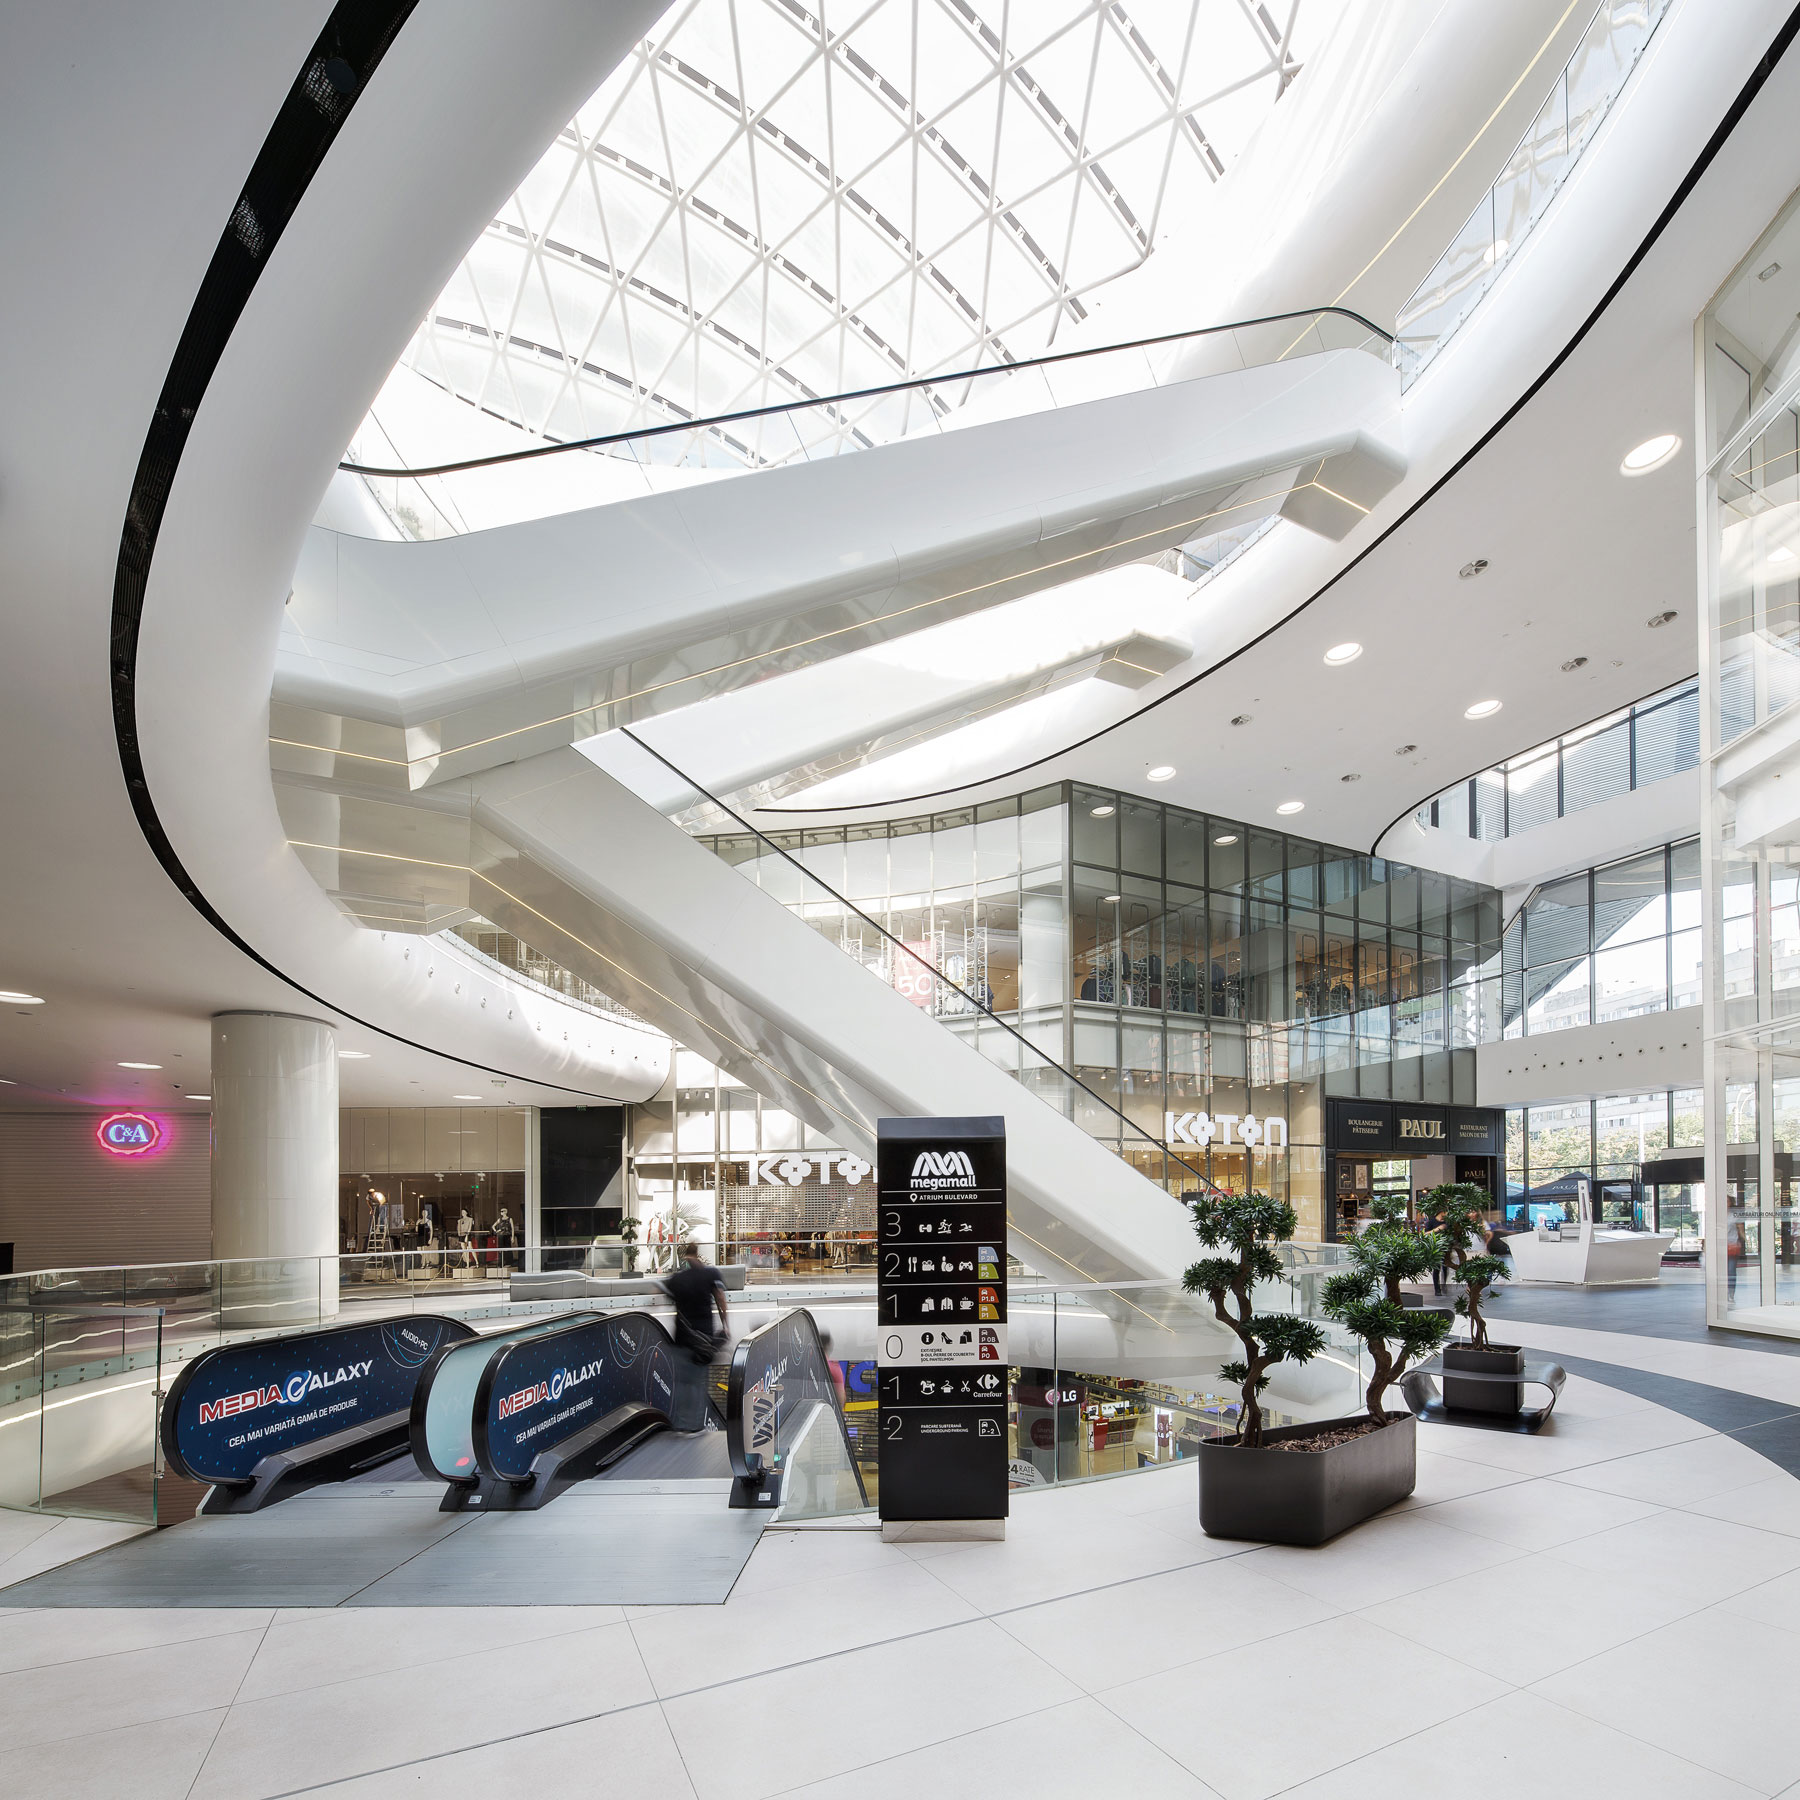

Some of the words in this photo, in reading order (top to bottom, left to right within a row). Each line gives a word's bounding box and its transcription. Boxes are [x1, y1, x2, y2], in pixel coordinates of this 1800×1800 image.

[109, 1124, 149, 1143] C&A
[1165, 1111, 1288, 1147] KOTON
[1348, 1119, 1384, 1127] BOULANGERIE
[1352, 1126, 1379, 1135] PÂTISSERIE
[1399, 1118, 1446, 1139] PAUL
[1459, 1124, 1488, 1132] RESTAURANT
[748, 1152, 877, 1187] KOTO
[1464, 1170, 1485, 1178] PAUL
[910, 1174, 977, 1191] megamall
[885, 1212, 901, 1237] 3
[885, 1253, 901, 1278] 2
[886, 1294, 898, 1318] 1
[401, 1328, 428, 1350] AUDIO+PC
[885, 1334, 903, 1359] 0
[200, 1384, 284, 1425] MEDIA
[285, 1360, 373, 1404] GALAXY
[499, 1381, 549, 1420] MEDIA
[551, 1358, 603, 1400] GALAXY
[883, 1376, 900, 1400] -1
[1062, 1390, 1077, 1402] LG
[229, 1435, 246, 1448] CEA
[247, 1429, 263, 1442] MAI
[264, 1418, 297, 1436] VARIATĂ
[297, 1409, 319, 1425] GAMĂ
[319, 1407, 328, 1417] DE
[328, 1398, 358, 1415] PRODUSE
[516, 1431, 527, 1443] CEA
[527, 1426, 537, 1438] MAI
[537, 1415, 557, 1432] VARIATĂ
[556, 1408, 570, 1423] GAMĂ
[570, 1406, 576, 1415] DE
[575, 1397, 594, 1412] PRODUSE
[883, 1415, 903, 1440] -2
[1019, 1465, 1034, 1474] RATE
